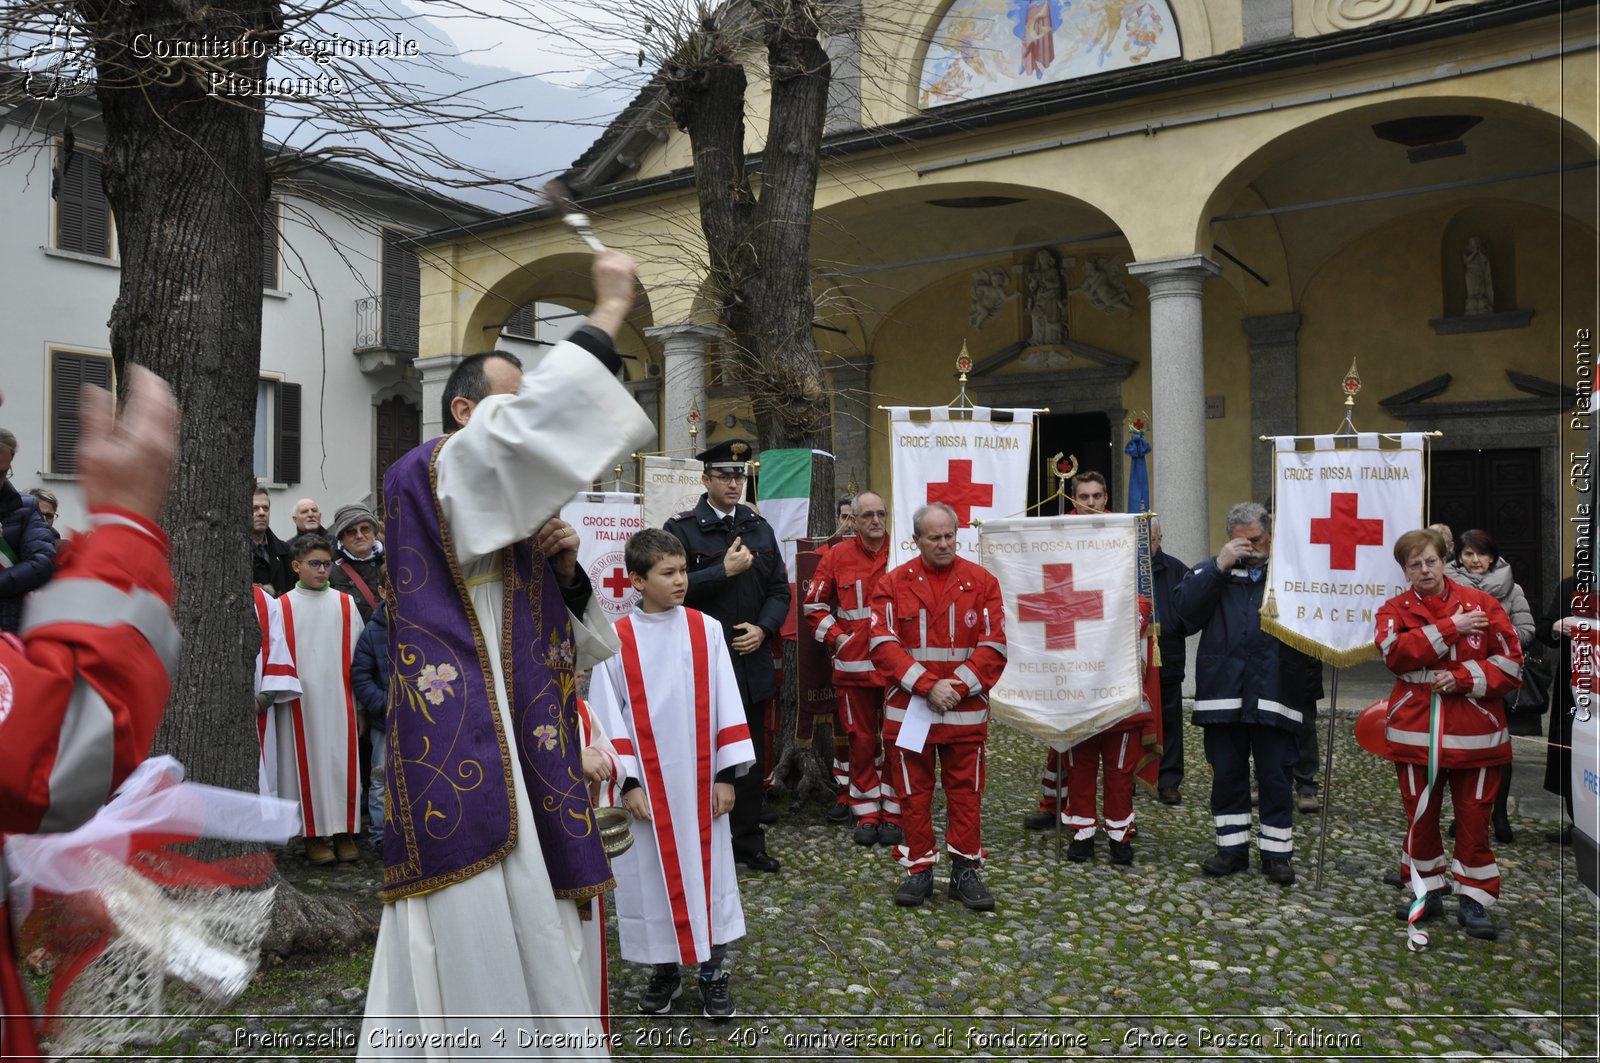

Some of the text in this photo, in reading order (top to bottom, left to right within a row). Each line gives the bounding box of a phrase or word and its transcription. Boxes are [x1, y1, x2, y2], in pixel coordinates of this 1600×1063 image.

[900, 435, 1019, 449] CROCE ROSSA ITALIANA
[652, 473, 703, 486] CROCE ROSS
[1284, 466, 1410, 481] CROCE ROSSA ITALIANA
[582, 516, 616, 527] CROCE
[987, 538, 1130, 555] CROCE ROSSA ITALIANA
[1284, 581, 1386, 596] DELEGAZIONE
[1018, 661, 1106, 673] DELEGAZIONE
[1055, 675, 1068, 686] DI
[997, 685, 1127, 701] GRAVELLONA TOCE
